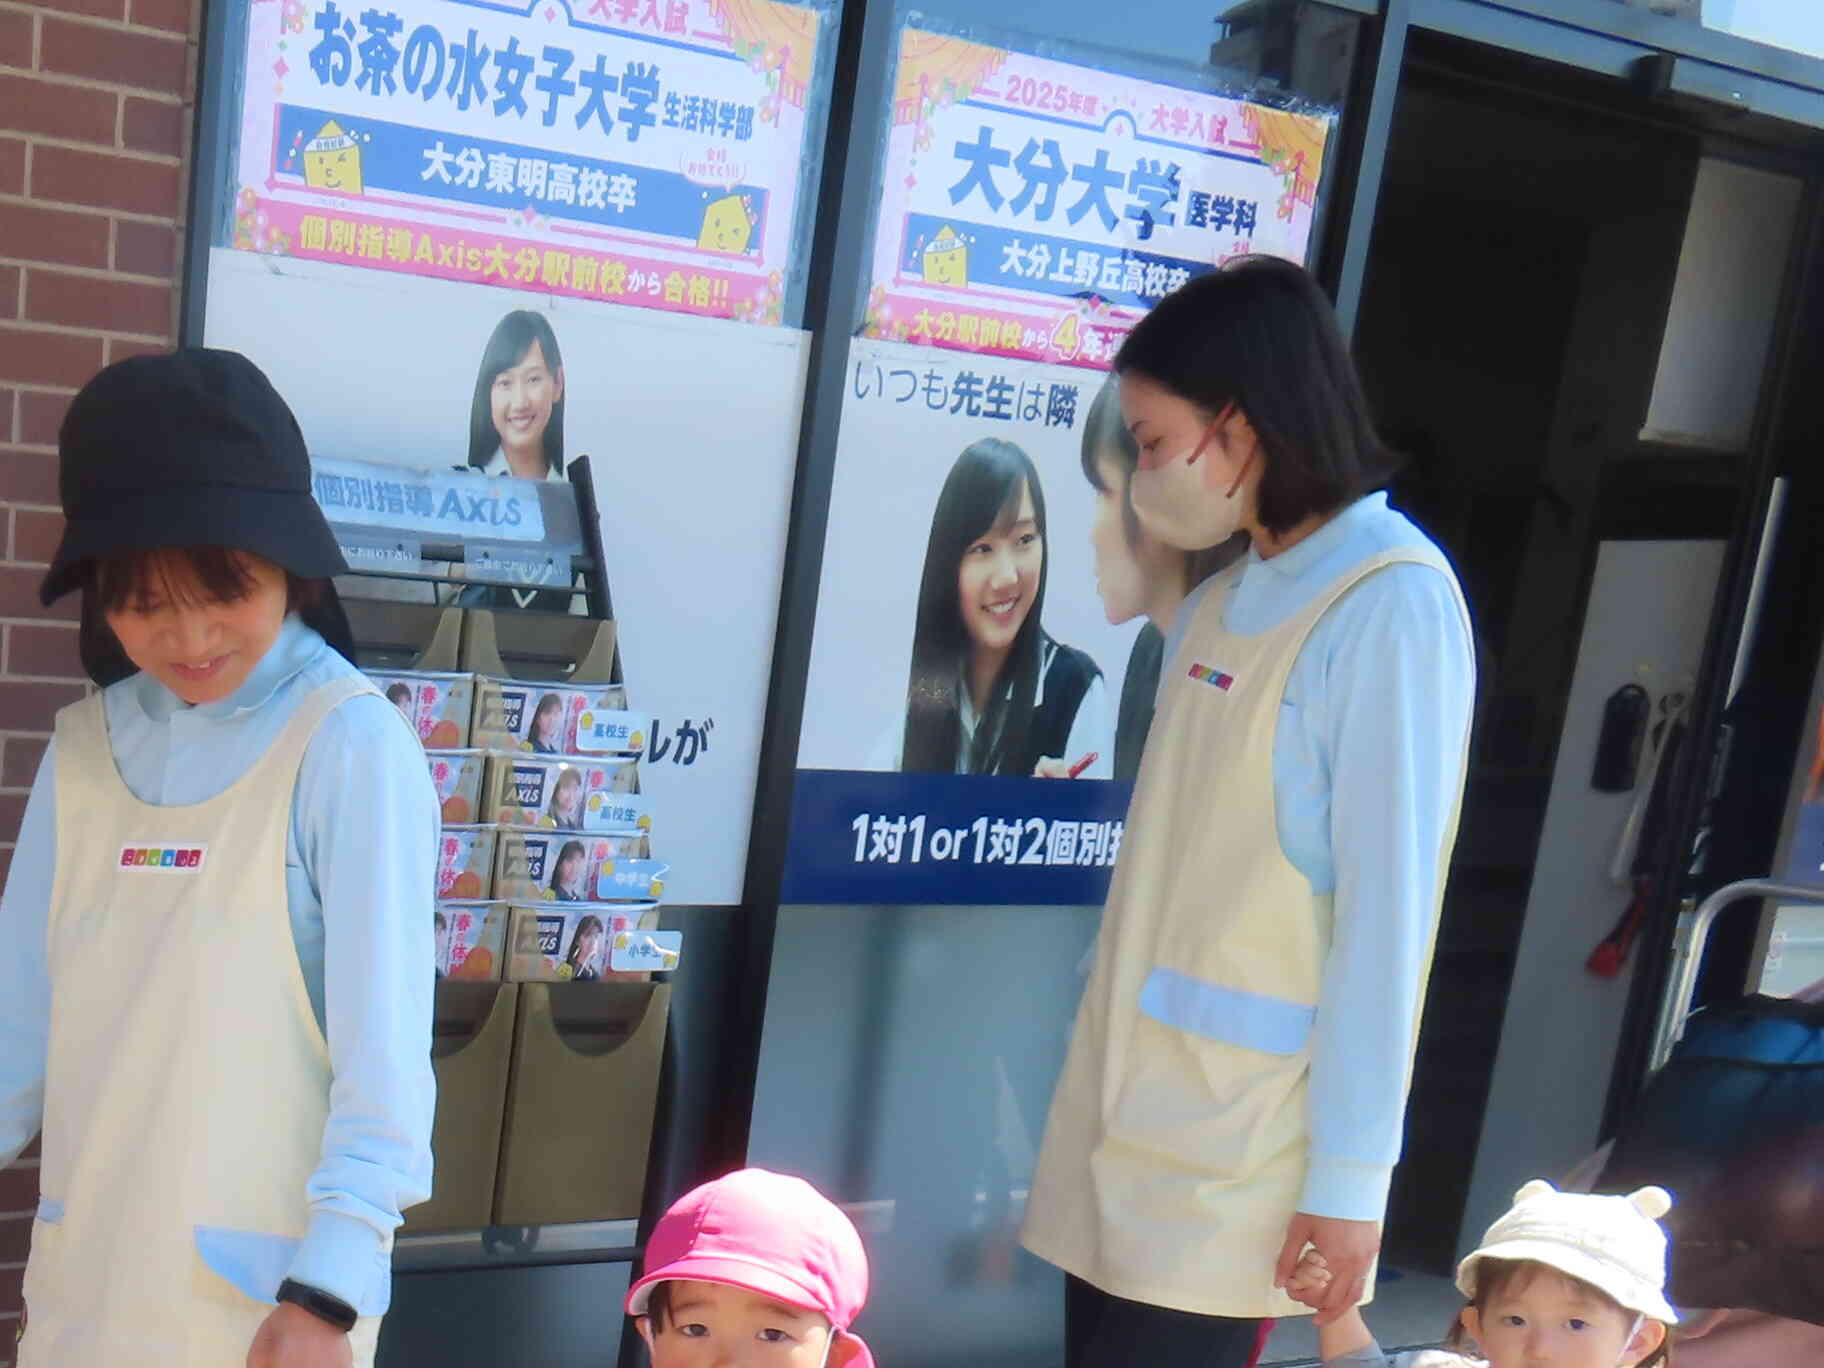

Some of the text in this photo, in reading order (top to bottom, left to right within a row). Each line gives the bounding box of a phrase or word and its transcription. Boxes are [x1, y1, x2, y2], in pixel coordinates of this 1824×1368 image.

[309, 1, 754, 142] お茶の水女子大学 生活科学部
[1004, 74, 1100, 117] 2025年度
[1148, 103, 1229, 146] 大学入試
[421, 141, 638, 213] 大分東明高校卒
[948, 125, 1259, 240] 大分大学 医学科
[854, 361, 1079, 429] いつも先生は隣
